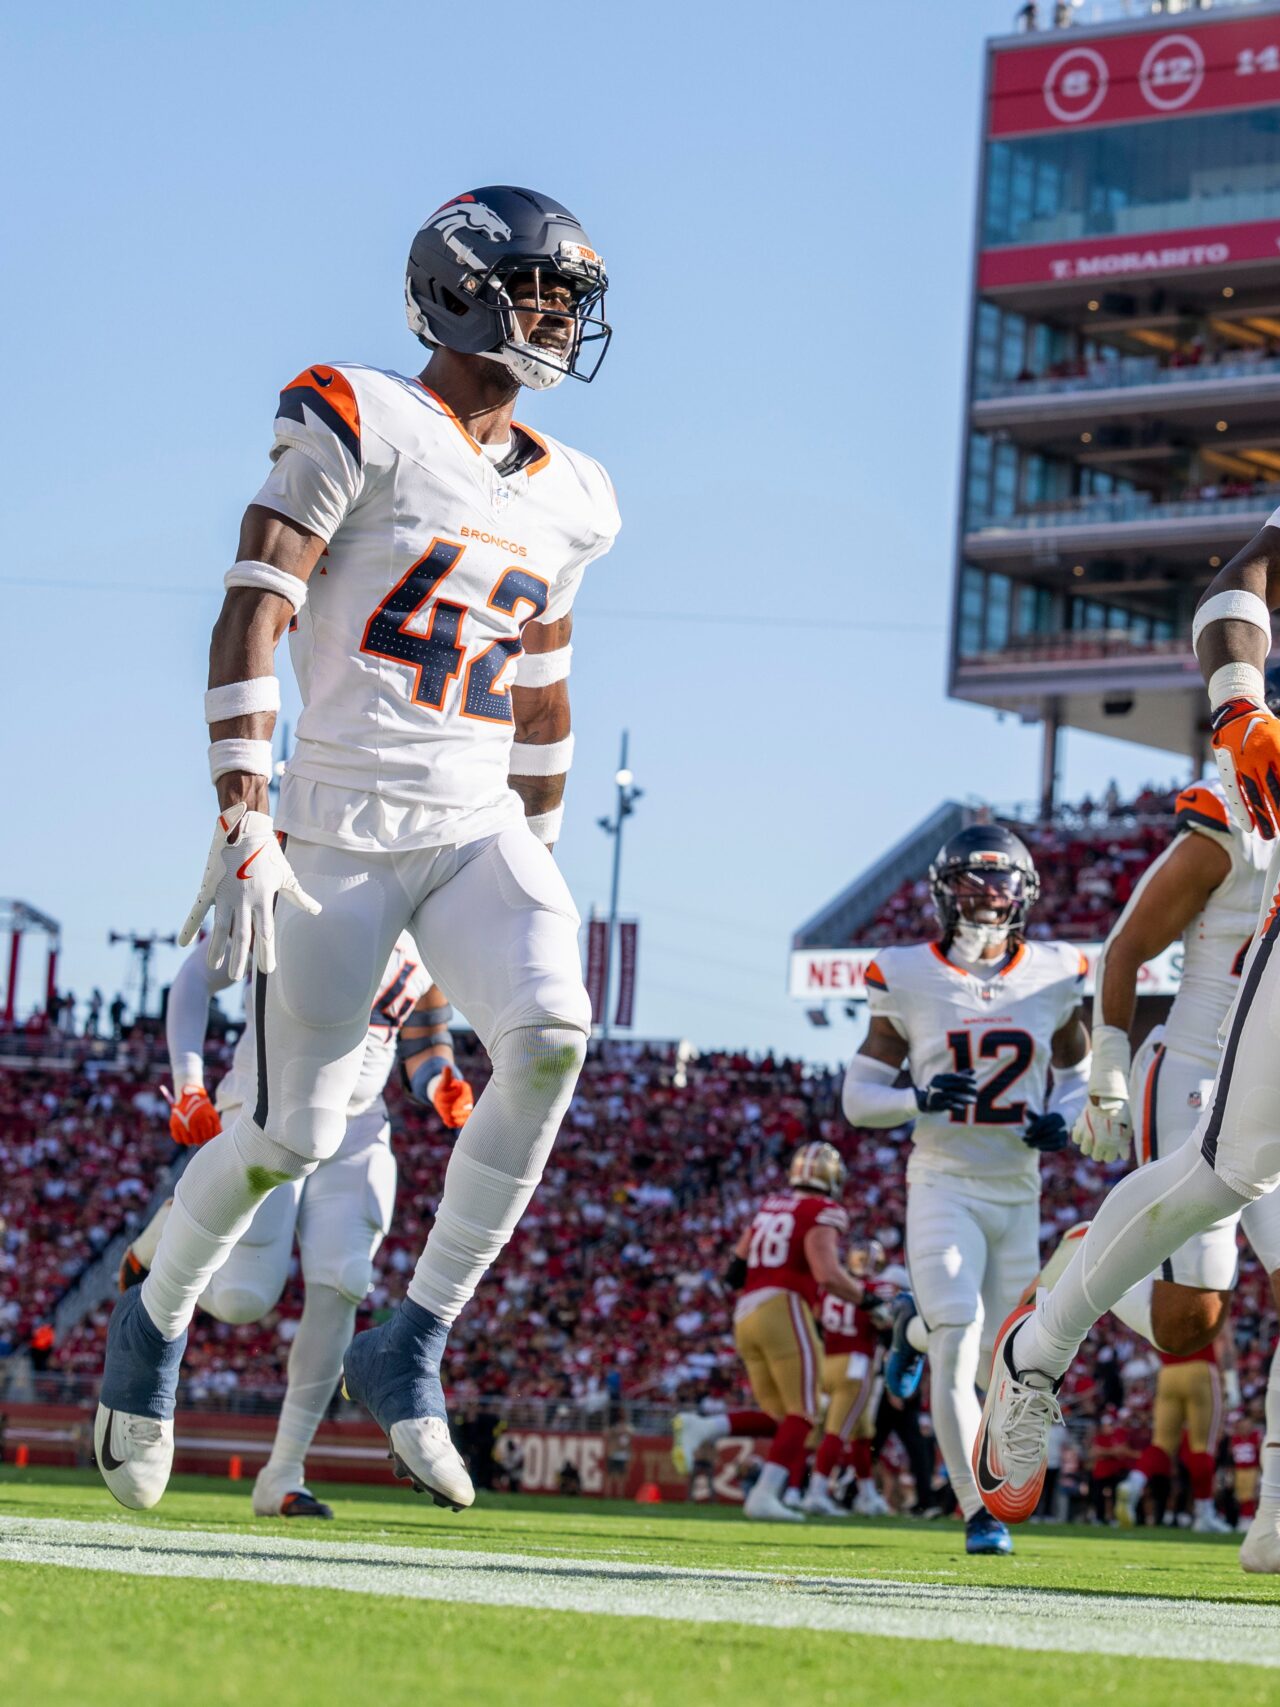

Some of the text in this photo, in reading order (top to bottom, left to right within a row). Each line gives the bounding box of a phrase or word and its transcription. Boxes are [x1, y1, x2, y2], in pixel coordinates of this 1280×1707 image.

[1151, 56, 1194, 87] 12
[1074, 242, 1230, 279] MORABITO
[460, 526, 528, 557] BRONCOS
[359, 537, 550, 725] 42
[946, 1028, 1035, 1126] 12
[747, 1211, 795, 1268] 78
[822, 1293, 858, 1337] 61
